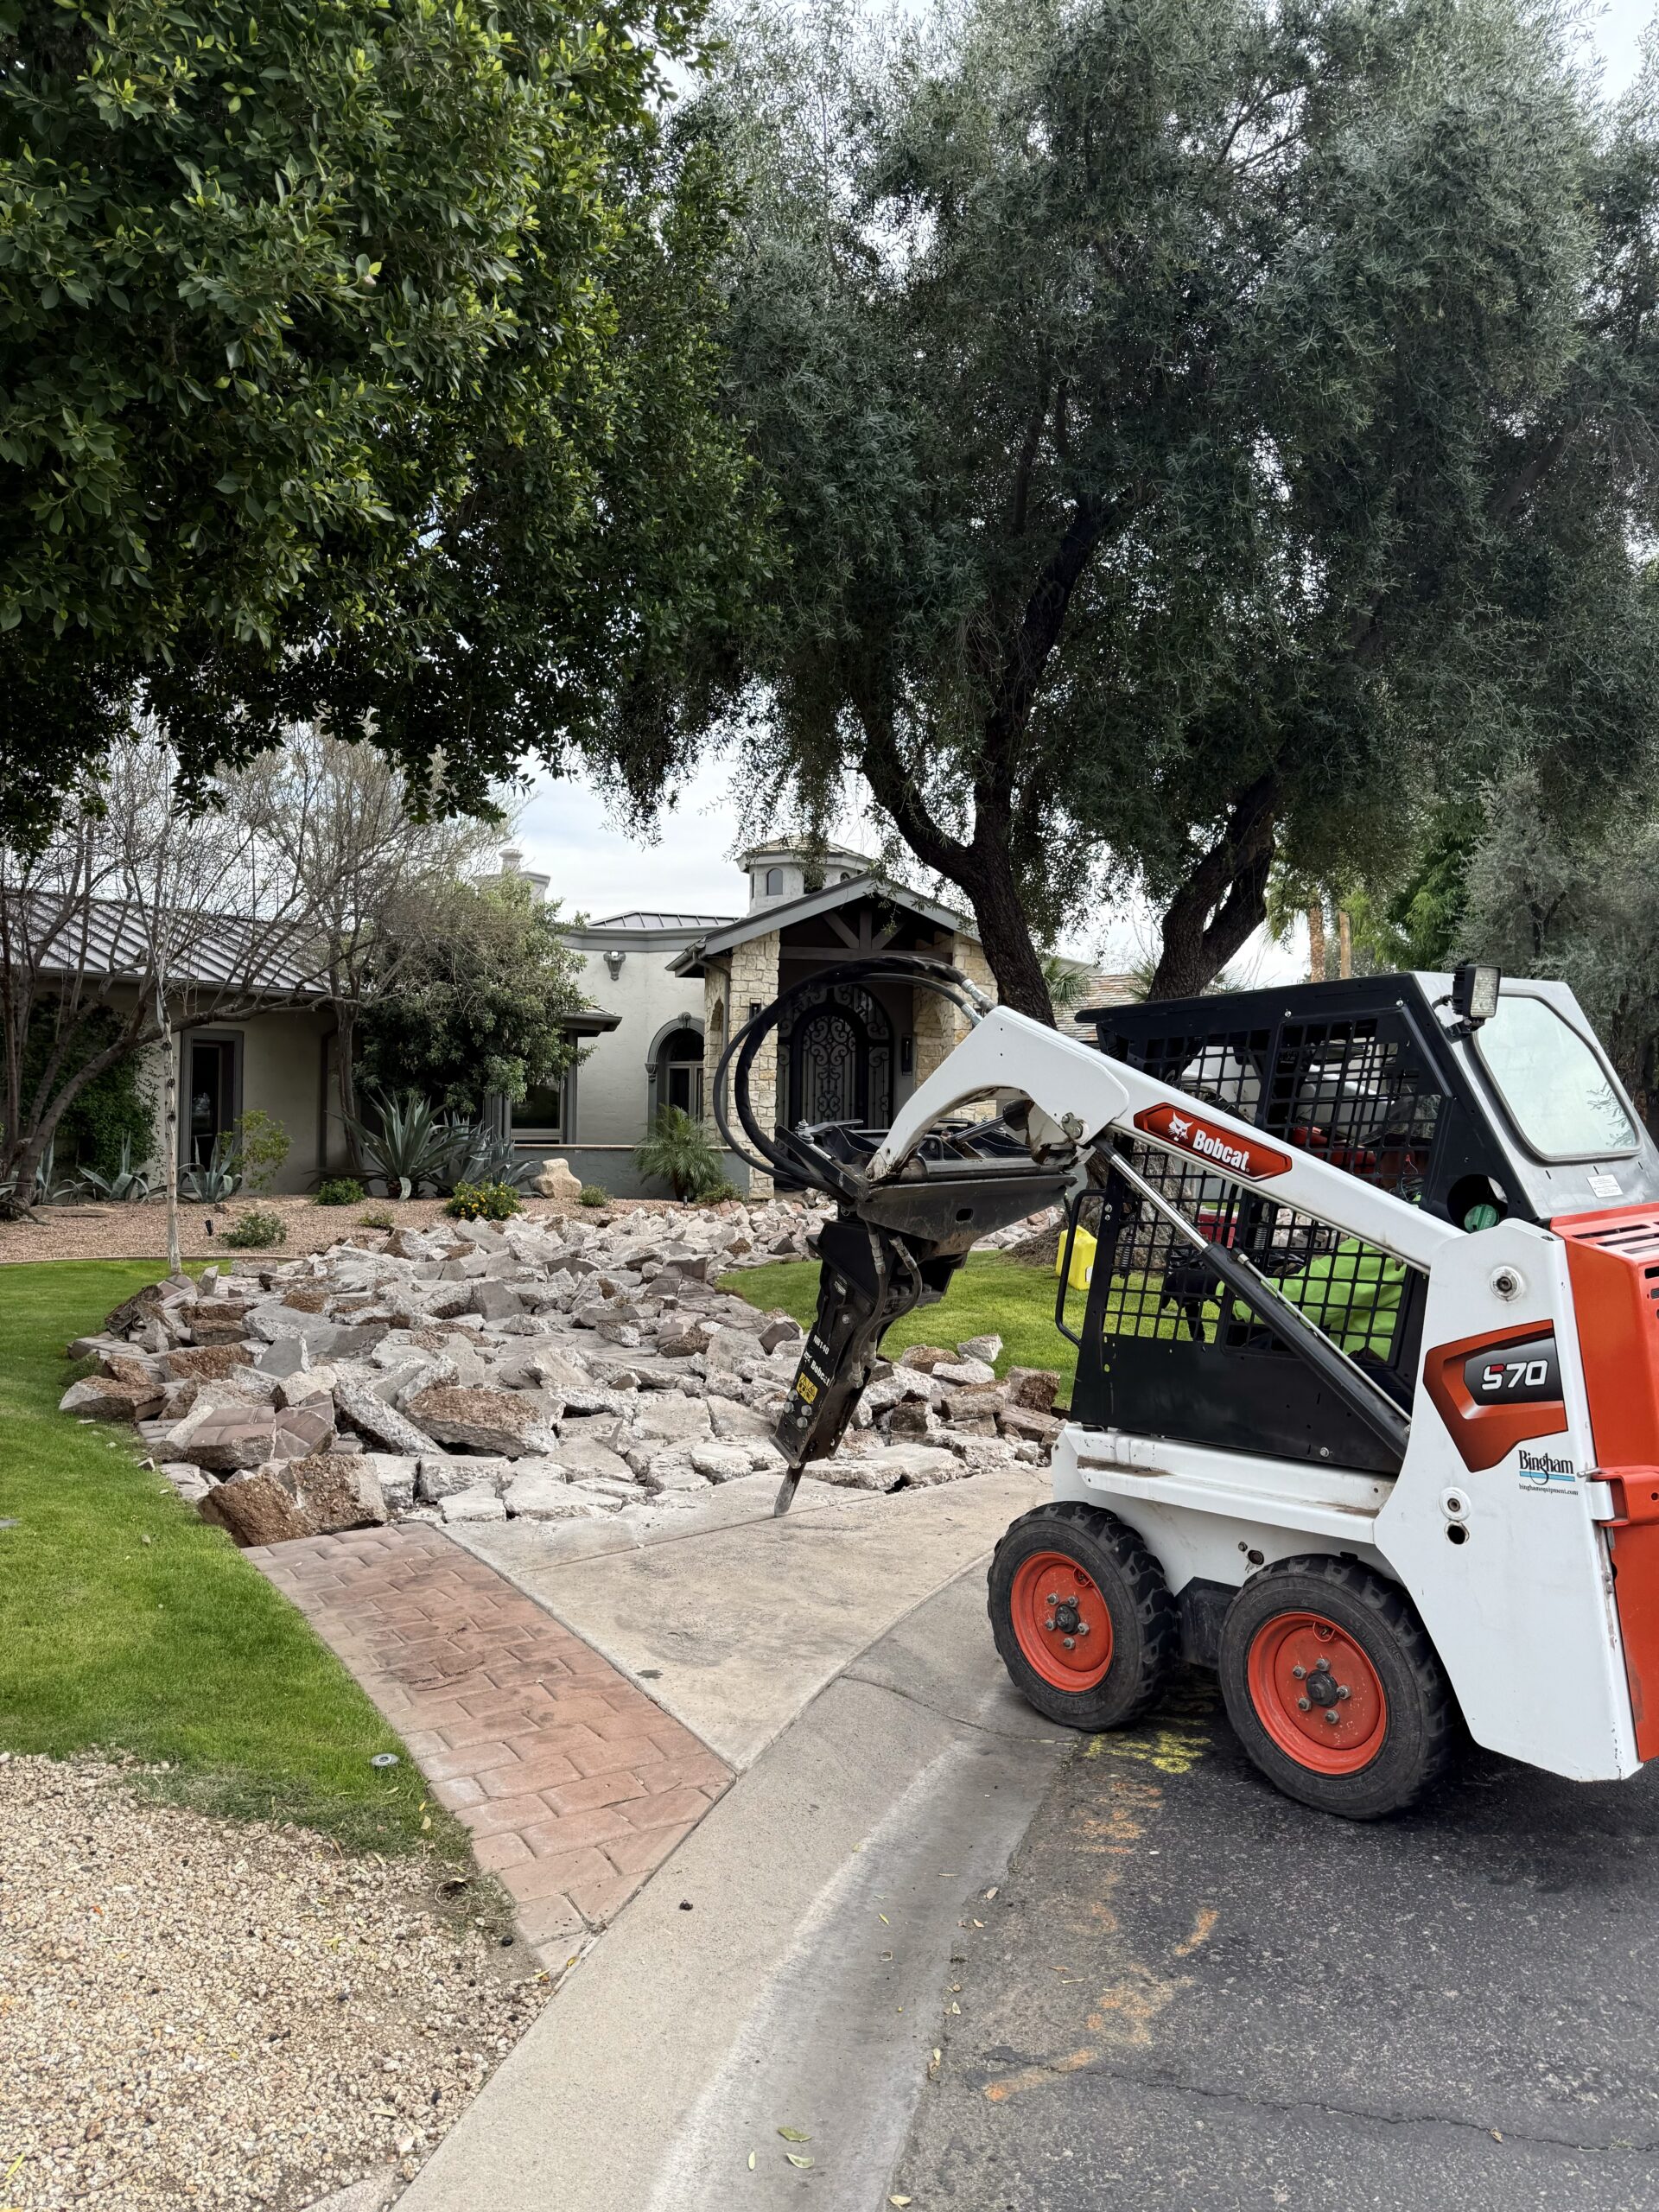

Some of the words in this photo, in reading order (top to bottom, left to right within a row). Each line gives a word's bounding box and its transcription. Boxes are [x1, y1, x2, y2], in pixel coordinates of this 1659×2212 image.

[1193, 1129, 1249, 1171] Bobcat
[1482, 1360, 1548, 1390] S70
[1518, 1450, 1573, 1485] Bingham
